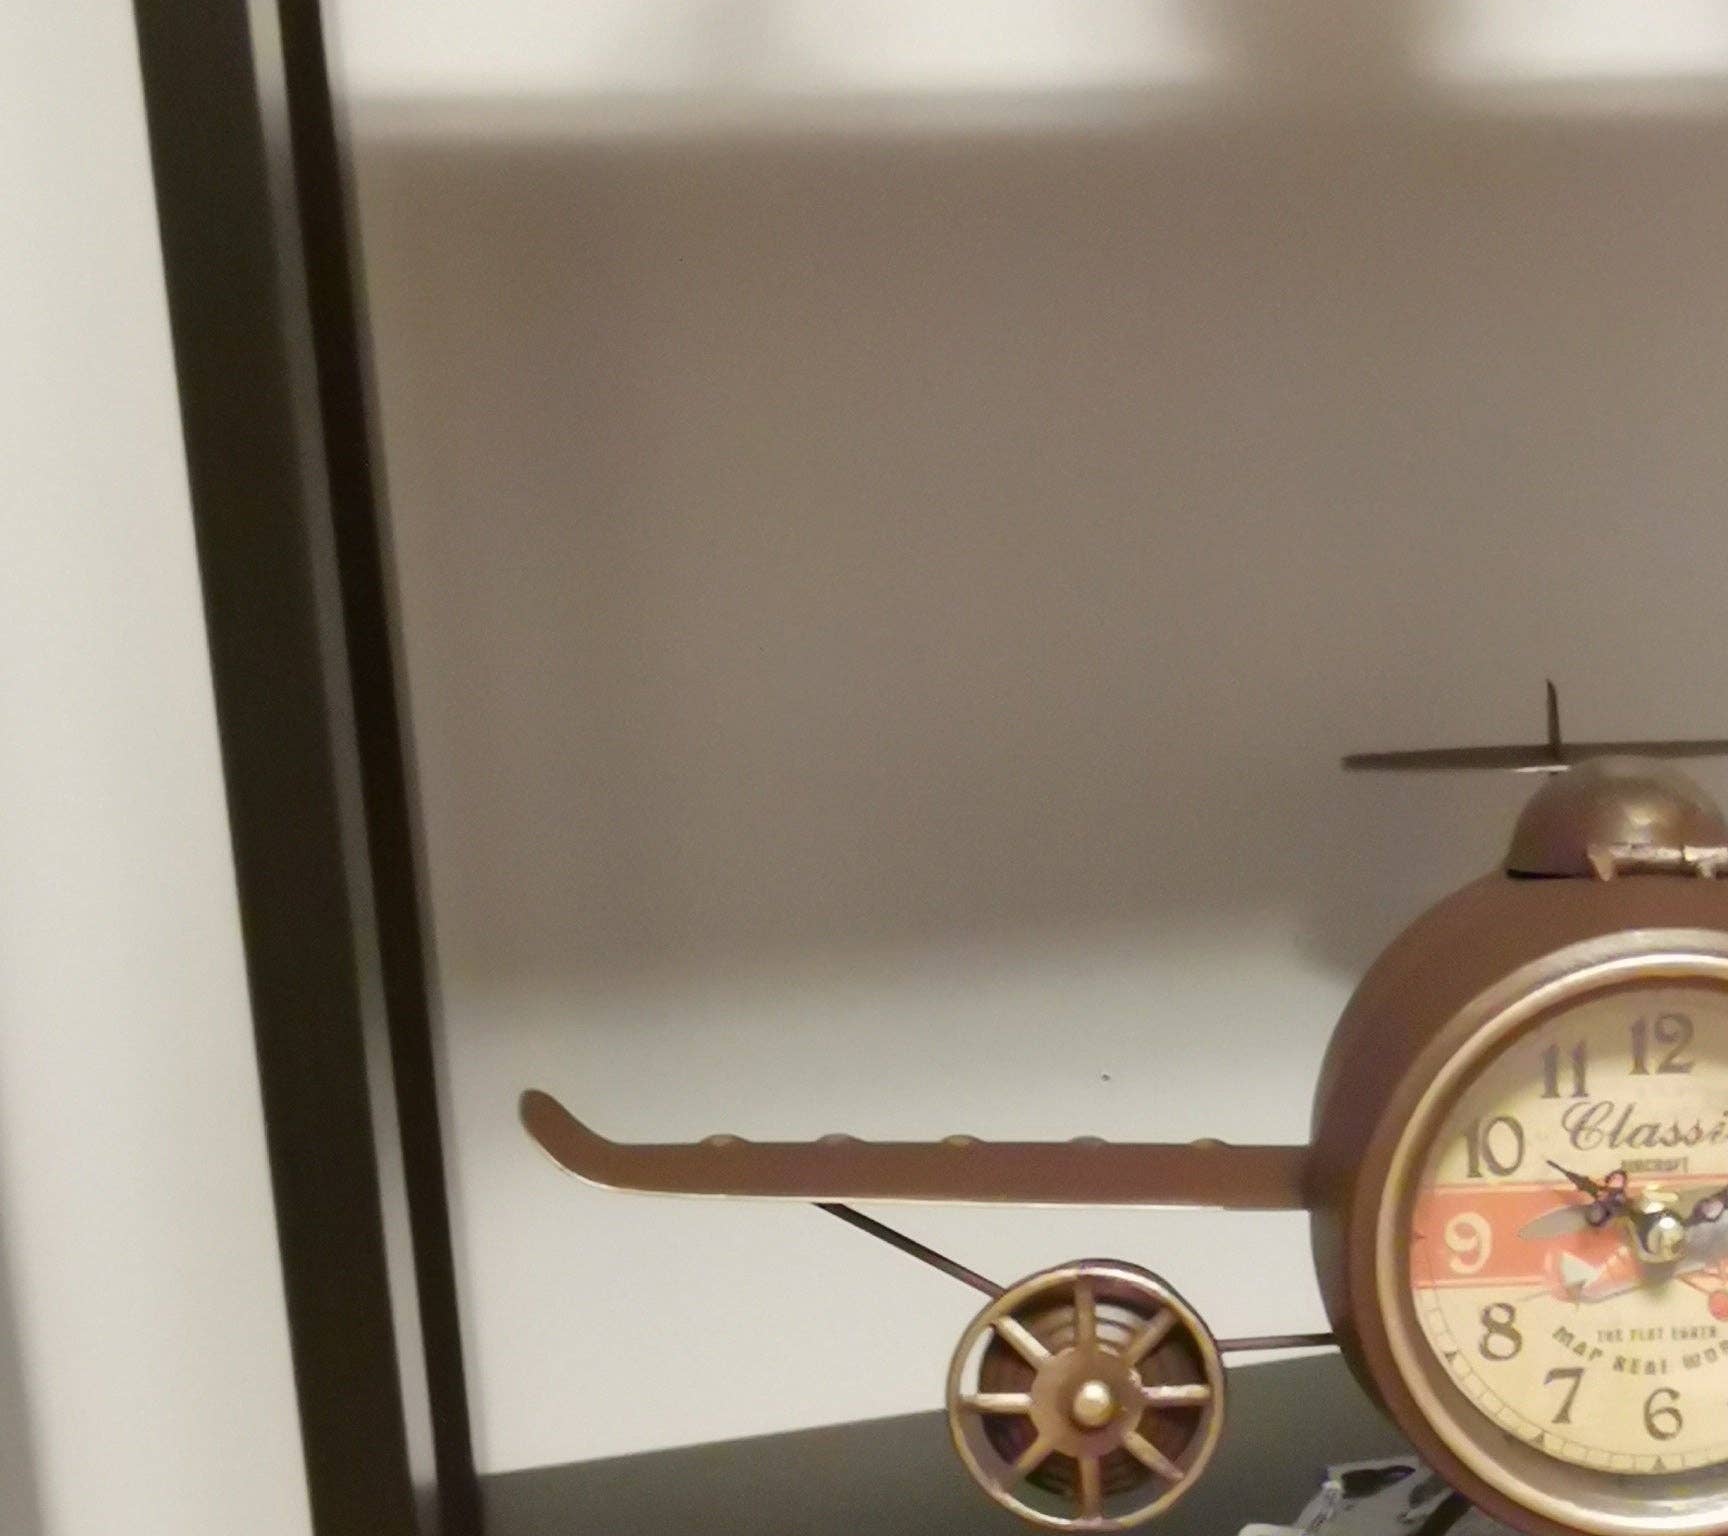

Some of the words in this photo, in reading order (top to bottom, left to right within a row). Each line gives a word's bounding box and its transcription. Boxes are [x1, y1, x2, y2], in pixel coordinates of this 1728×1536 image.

[1540, 1040, 1589, 1098] 11
[1628, 1012, 1695, 1075] 12
[1464, 1115, 1526, 1178] 10
[1443, 1211, 1493, 1275] 9
[1479, 1302, 1523, 1361] 8
[1552, 1325, 1603, 1361] MAP
[1543, 1366, 1584, 1424] 7
[1643, 1387, 1682, 1441] 6
